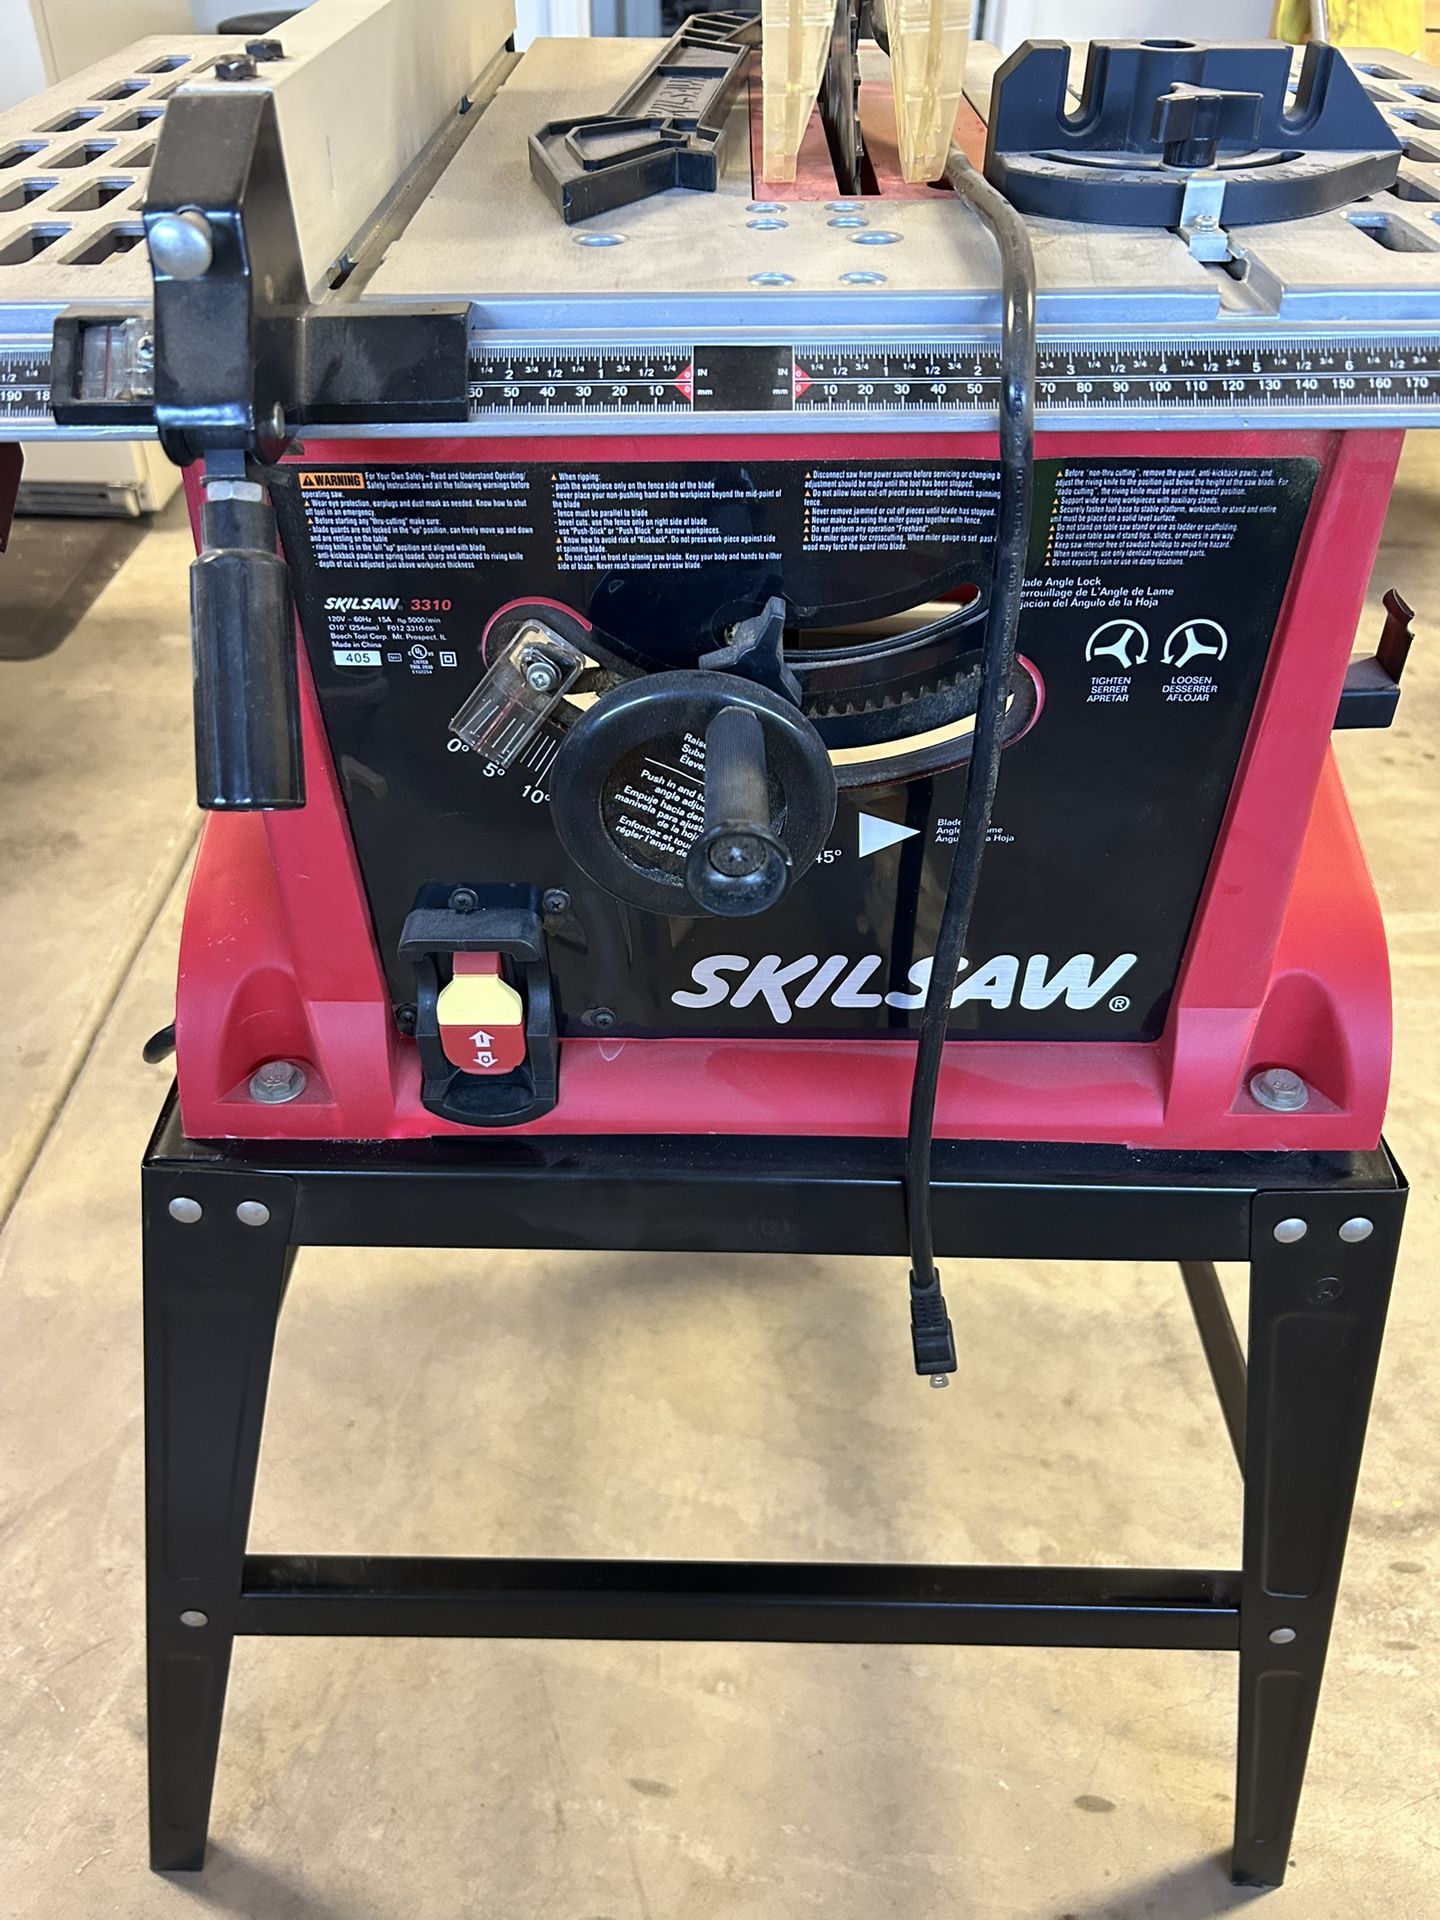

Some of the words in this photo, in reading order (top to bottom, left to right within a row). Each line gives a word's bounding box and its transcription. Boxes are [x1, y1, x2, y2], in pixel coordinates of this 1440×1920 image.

[504, 370, 514, 380] 2
[524, 366, 539, 374] 3/4
[547, 369, 563, 378] 1/2
[598, 368, 604, 379] 1
[616, 364, 630, 372] 3/4
[639, 368, 655, 377] 1/2
[697, 368, 708, 376] IN
[778, 368, 788, 376] IN
[832, 367, 848, 376] 1/2
[883, 366, 889, 377] 1
[924, 366, 941, 375] 1/2
[948, 362, 962, 370] 3/4
[974, 366, 982, 376] 2
[1066, 364, 1075, 375] 3
[1110, 364, 1126, 373] 1/2
[1158, 363, 1168, 374] 4
[1202, 362, 1219, 372] 1/2
[1252, 362, 1262, 373] 5
[1296, 360, 1313, 370] 1/2
[1344, 360, 1354, 371] 6
[1389, 359, 1406, 370] 1/2
[503, 387, 520, 397] 50
[539, 386, 556, 397] 40
[575, 386, 592, 397] 30
[611, 386, 628, 396] 20
[648, 385, 664, 396] 10
[796, 384, 801, 392] 0
[823, 384, 838, 395] 10
[857, 384, 874, 395] 20
[894, 384, 910, 395] 30
[930, 384, 947, 394] 40
[967, 384, 983, 394] 50
[1040, 382, 1056, 393] 70
[1076, 382, 1093, 393] 80
[1112, 382, 1129, 392] 90
[1148, 381, 1172, 392] 100
[1185, 380, 1208, 392] 110
[1222, 380, 1245, 391] 120
[1259, 380, 1282, 390] 130
[1295, 378, 1318, 390] 140
[1332, 378, 1355, 389] 150
[1368, 378, 1392, 389] 160
[1405, 377, 1429, 388] 170
[0, 390, 23, 401] 190
[36, 390, 50, 401] 18
[314, 474, 361, 487] WARNING
[558, 472, 576, 481] When
[574, 508, 590, 517] must
[590, 508, 599, 517] be
[599, 508, 623, 518] parallel
[623, 509, 630, 517] to
[631, 508, 648, 517] blade
[1051, 558, 1060, 566] Do
[1060, 558, 1071, 566] not
[1021, 578, 1043, 587] lade
[1044, 577, 1074, 588] Angle
[1077, 576, 1102, 586] Lock
[1020, 588, 1073, 599] errouillage
[1076, 588, 1088, 597] de
[1090, 587, 1129, 598] L'Angle
[1131, 587, 1144, 596] de
[1147, 587, 1174, 596] Lame
[324, 597, 400, 613] SKILSAW
[410, 599, 452, 611] 3310
[1020, 599, 1050, 610] jación
[1052, 598, 1068, 608] del
[1108, 597, 1120, 607] de
[1123, 597, 1133, 606] la
[1134, 597, 1159, 608] Hoja
[407, 616, 441, 624] 5000/min
[386, 624, 404, 632] F012
[406, 624, 424, 632] 3310
[353, 632, 368, 640] Tool
[369, 633, 389, 641] Corp.
[346, 654, 370, 664] 405
[1090, 676, 1132, 685] TIGHTEN
[1171, 676, 1212, 684] LOOSEN
[1090, 686, 1128, 694] SERRER
[1161, 684, 1218, 693] DESSERRER
[1086, 694, 1129, 702] APRETAR
[1166, 694, 1210, 702] AFLOJAR
[681, 743, 705, 759] Suba
[679, 753, 706, 772] Éleve
[640, 768, 666, 786] Push
[666, 779, 677, 789] in
[677, 785, 696, 798] and
[697, 792, 706, 803] tu
[623, 784, 659, 805] Empuje
[660, 800, 686, 817] hacia
[686, 812, 705, 824] den
[654, 786, 680, 802] angle
[681, 796, 705, 813] adjus
[614, 793, 656, 814] manivela
[656, 810, 679, 824] para
[679, 820, 705, 834] ajust
[619, 815, 662, 838] Enfoncez
[662, 832, 673, 843] et
[673, 835, 692, 850] tou
[656, 819, 670, 830] de
[670, 824, 680, 834] la
[615, 824, 644, 840] régler
[644, 834, 675, 852] l'angle
[676, 848, 688, 858] de
[993, 834, 1015, 843] Hoja
